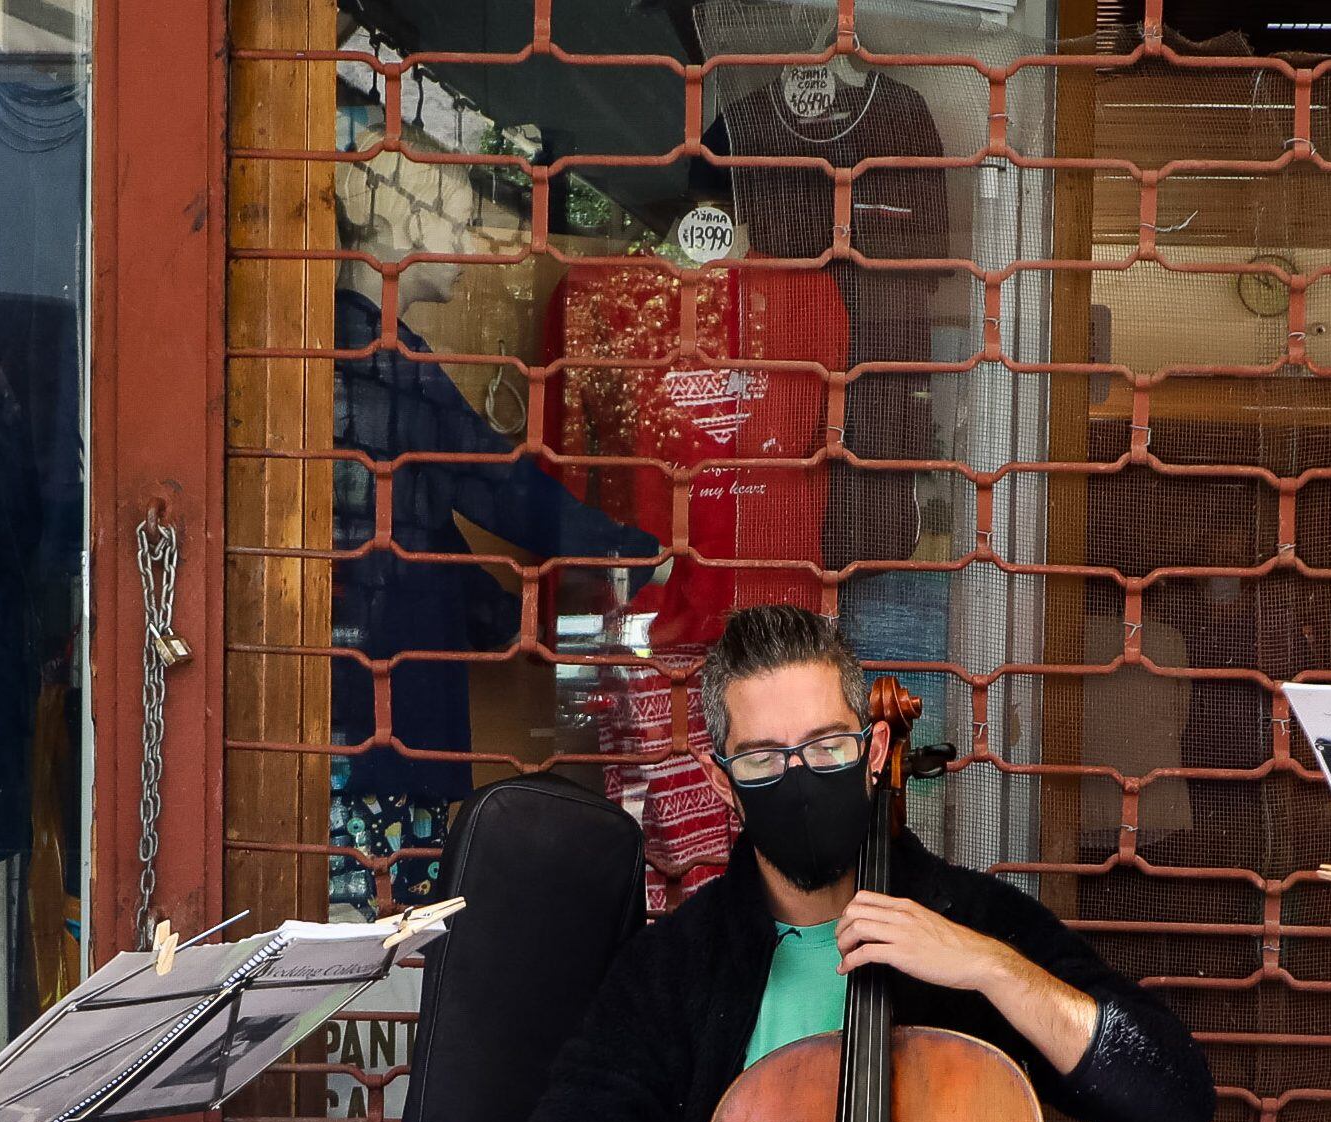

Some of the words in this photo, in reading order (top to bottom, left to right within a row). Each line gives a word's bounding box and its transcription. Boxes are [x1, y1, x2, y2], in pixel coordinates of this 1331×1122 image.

[691, 210, 728, 224] PIJAMA
[699, 487, 725, 499] my
[729, 480, 767, 495] heart
